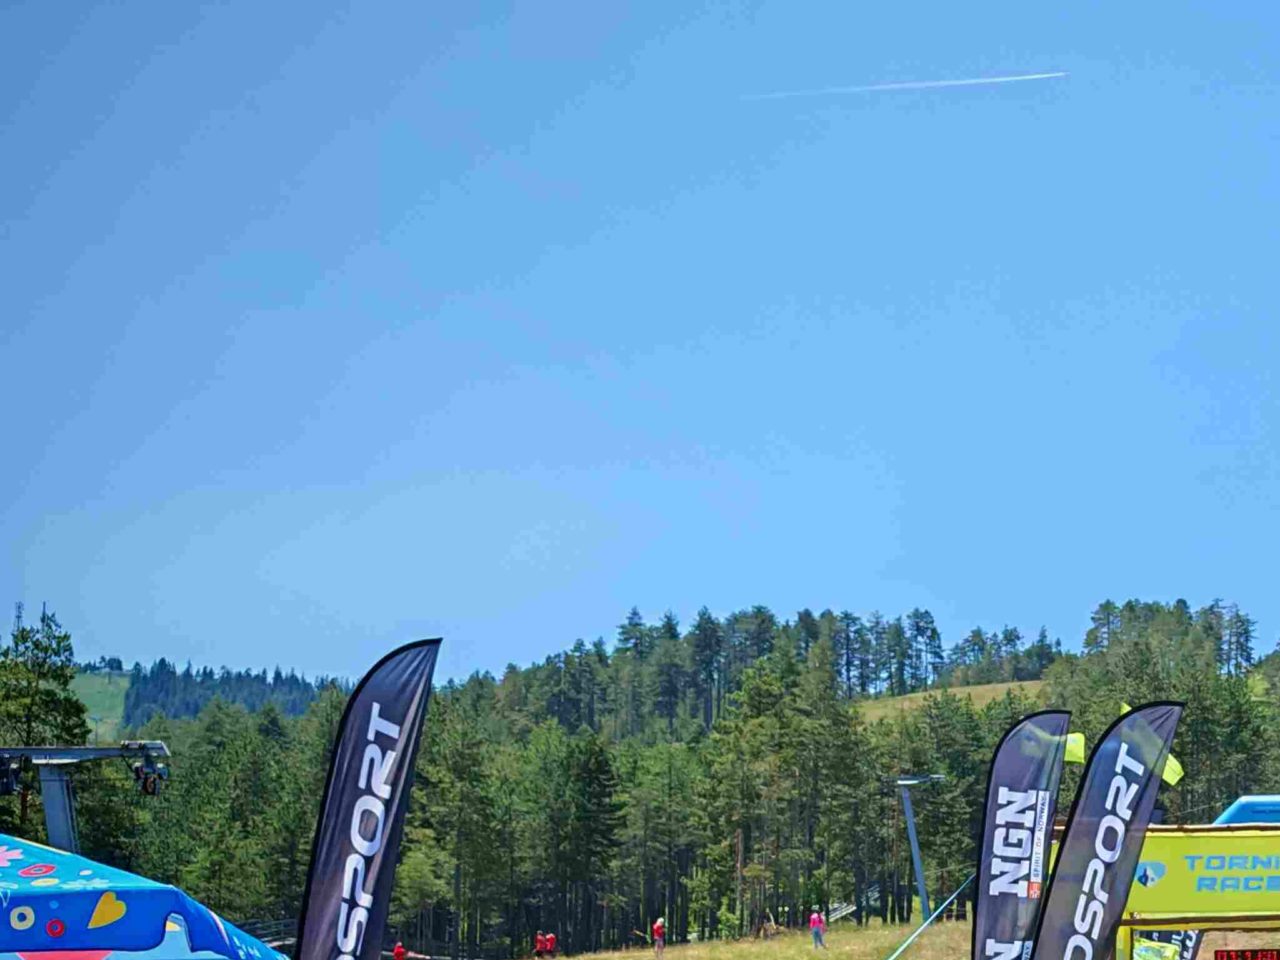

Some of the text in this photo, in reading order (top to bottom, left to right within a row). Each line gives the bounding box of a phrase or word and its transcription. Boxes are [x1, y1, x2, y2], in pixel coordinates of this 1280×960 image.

[1036, 795, 1047, 832] NORWAY
[989, 786, 1037, 897] NGN
[1032, 851, 1041, 878] SPIRIT
